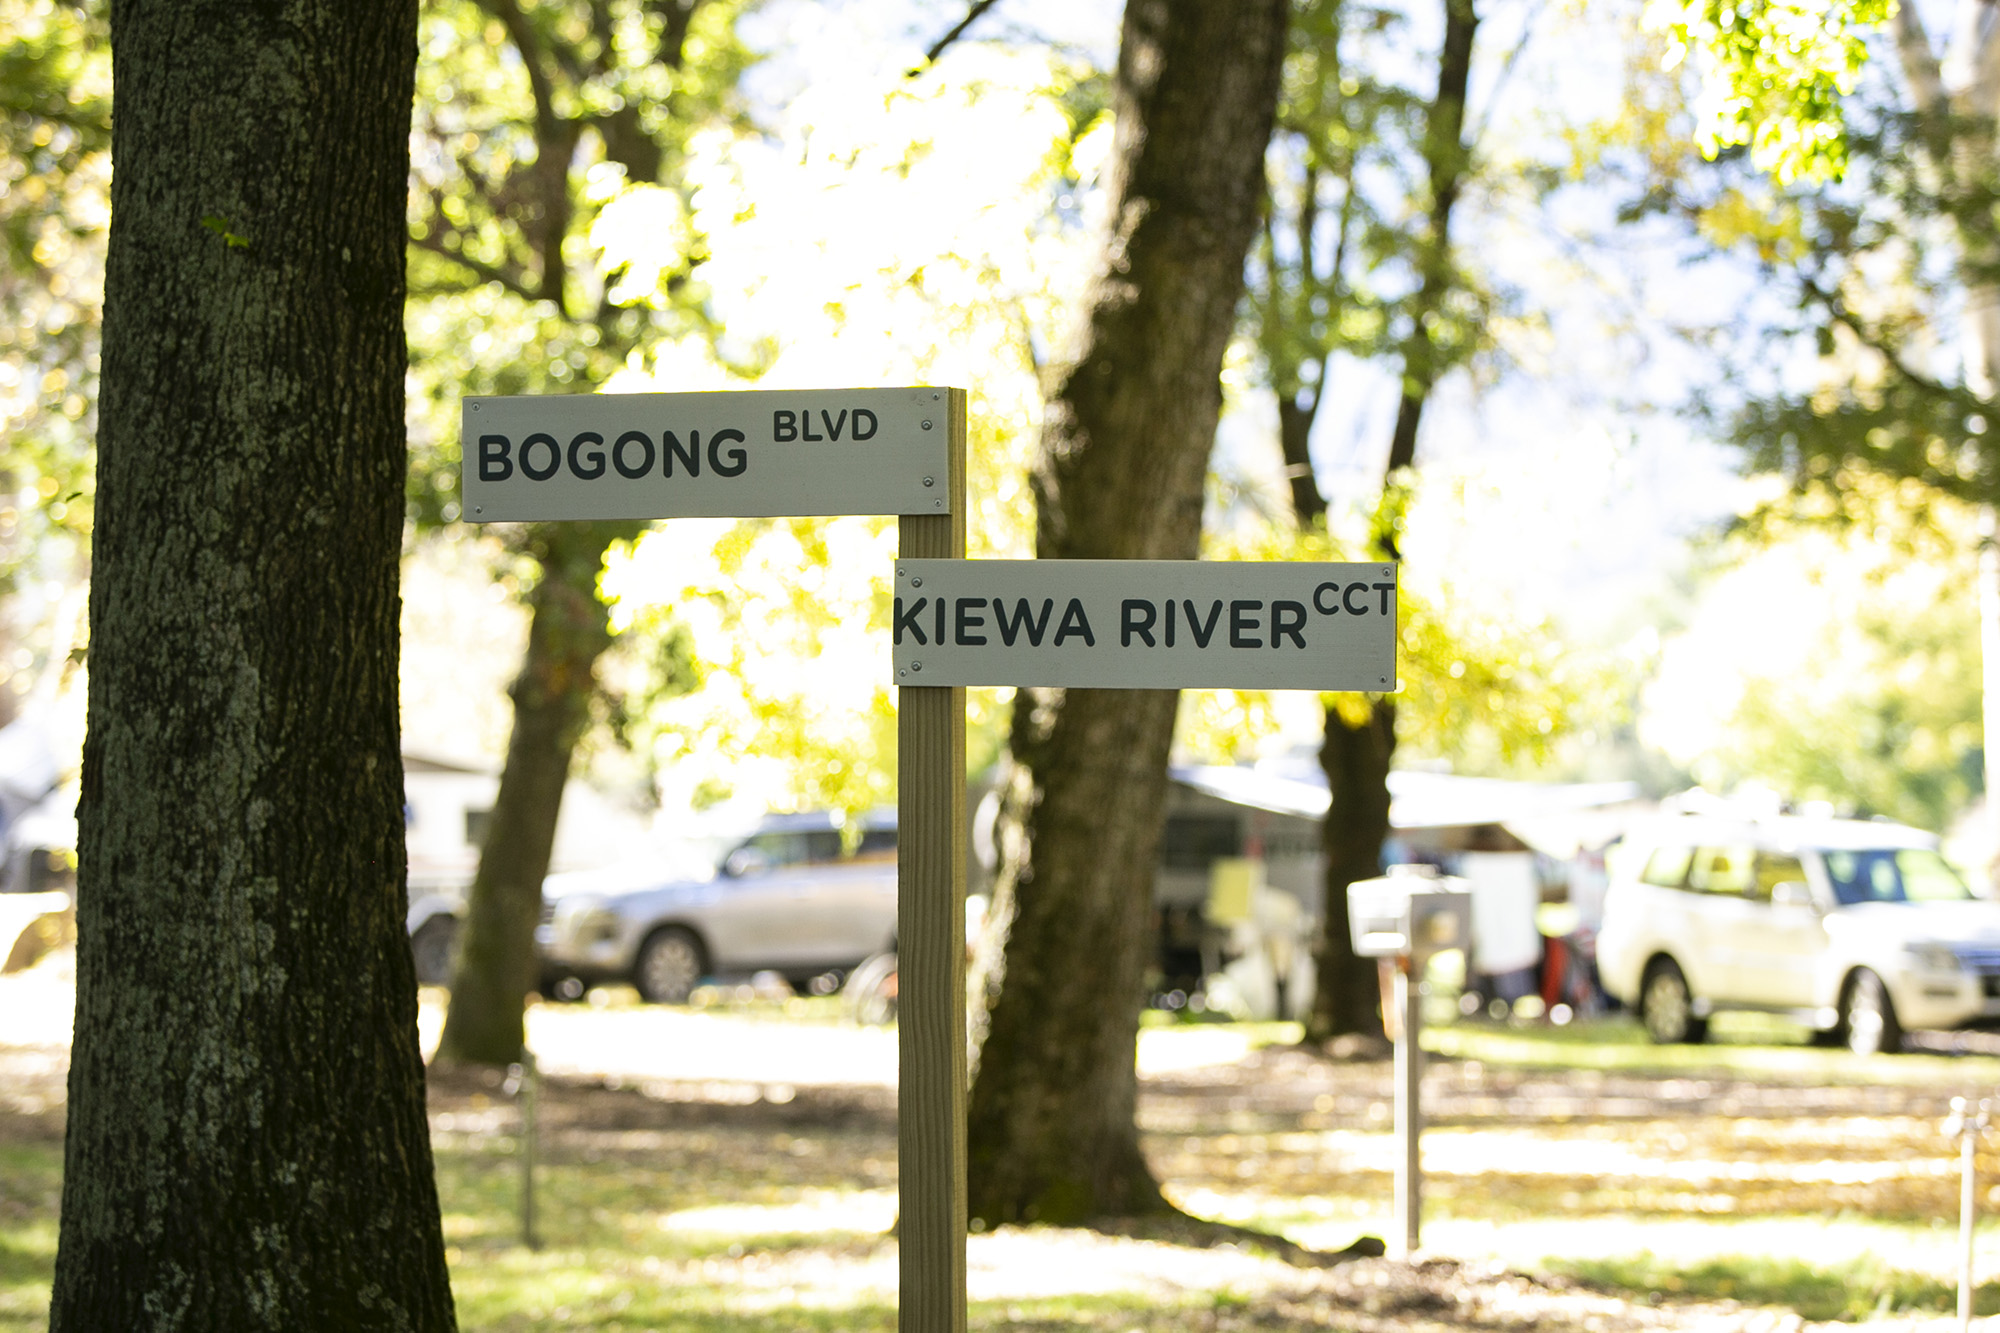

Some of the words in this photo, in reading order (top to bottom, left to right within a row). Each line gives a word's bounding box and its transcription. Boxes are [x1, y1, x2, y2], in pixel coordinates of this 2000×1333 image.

[478, 428, 748, 482] BOGONG
[774, 408, 879, 443] BLVD
[893, 596, 1096, 648] KIEWA
[1120, 598, 1308, 650] RIVER
[1312, 581, 1396, 616] CCT
